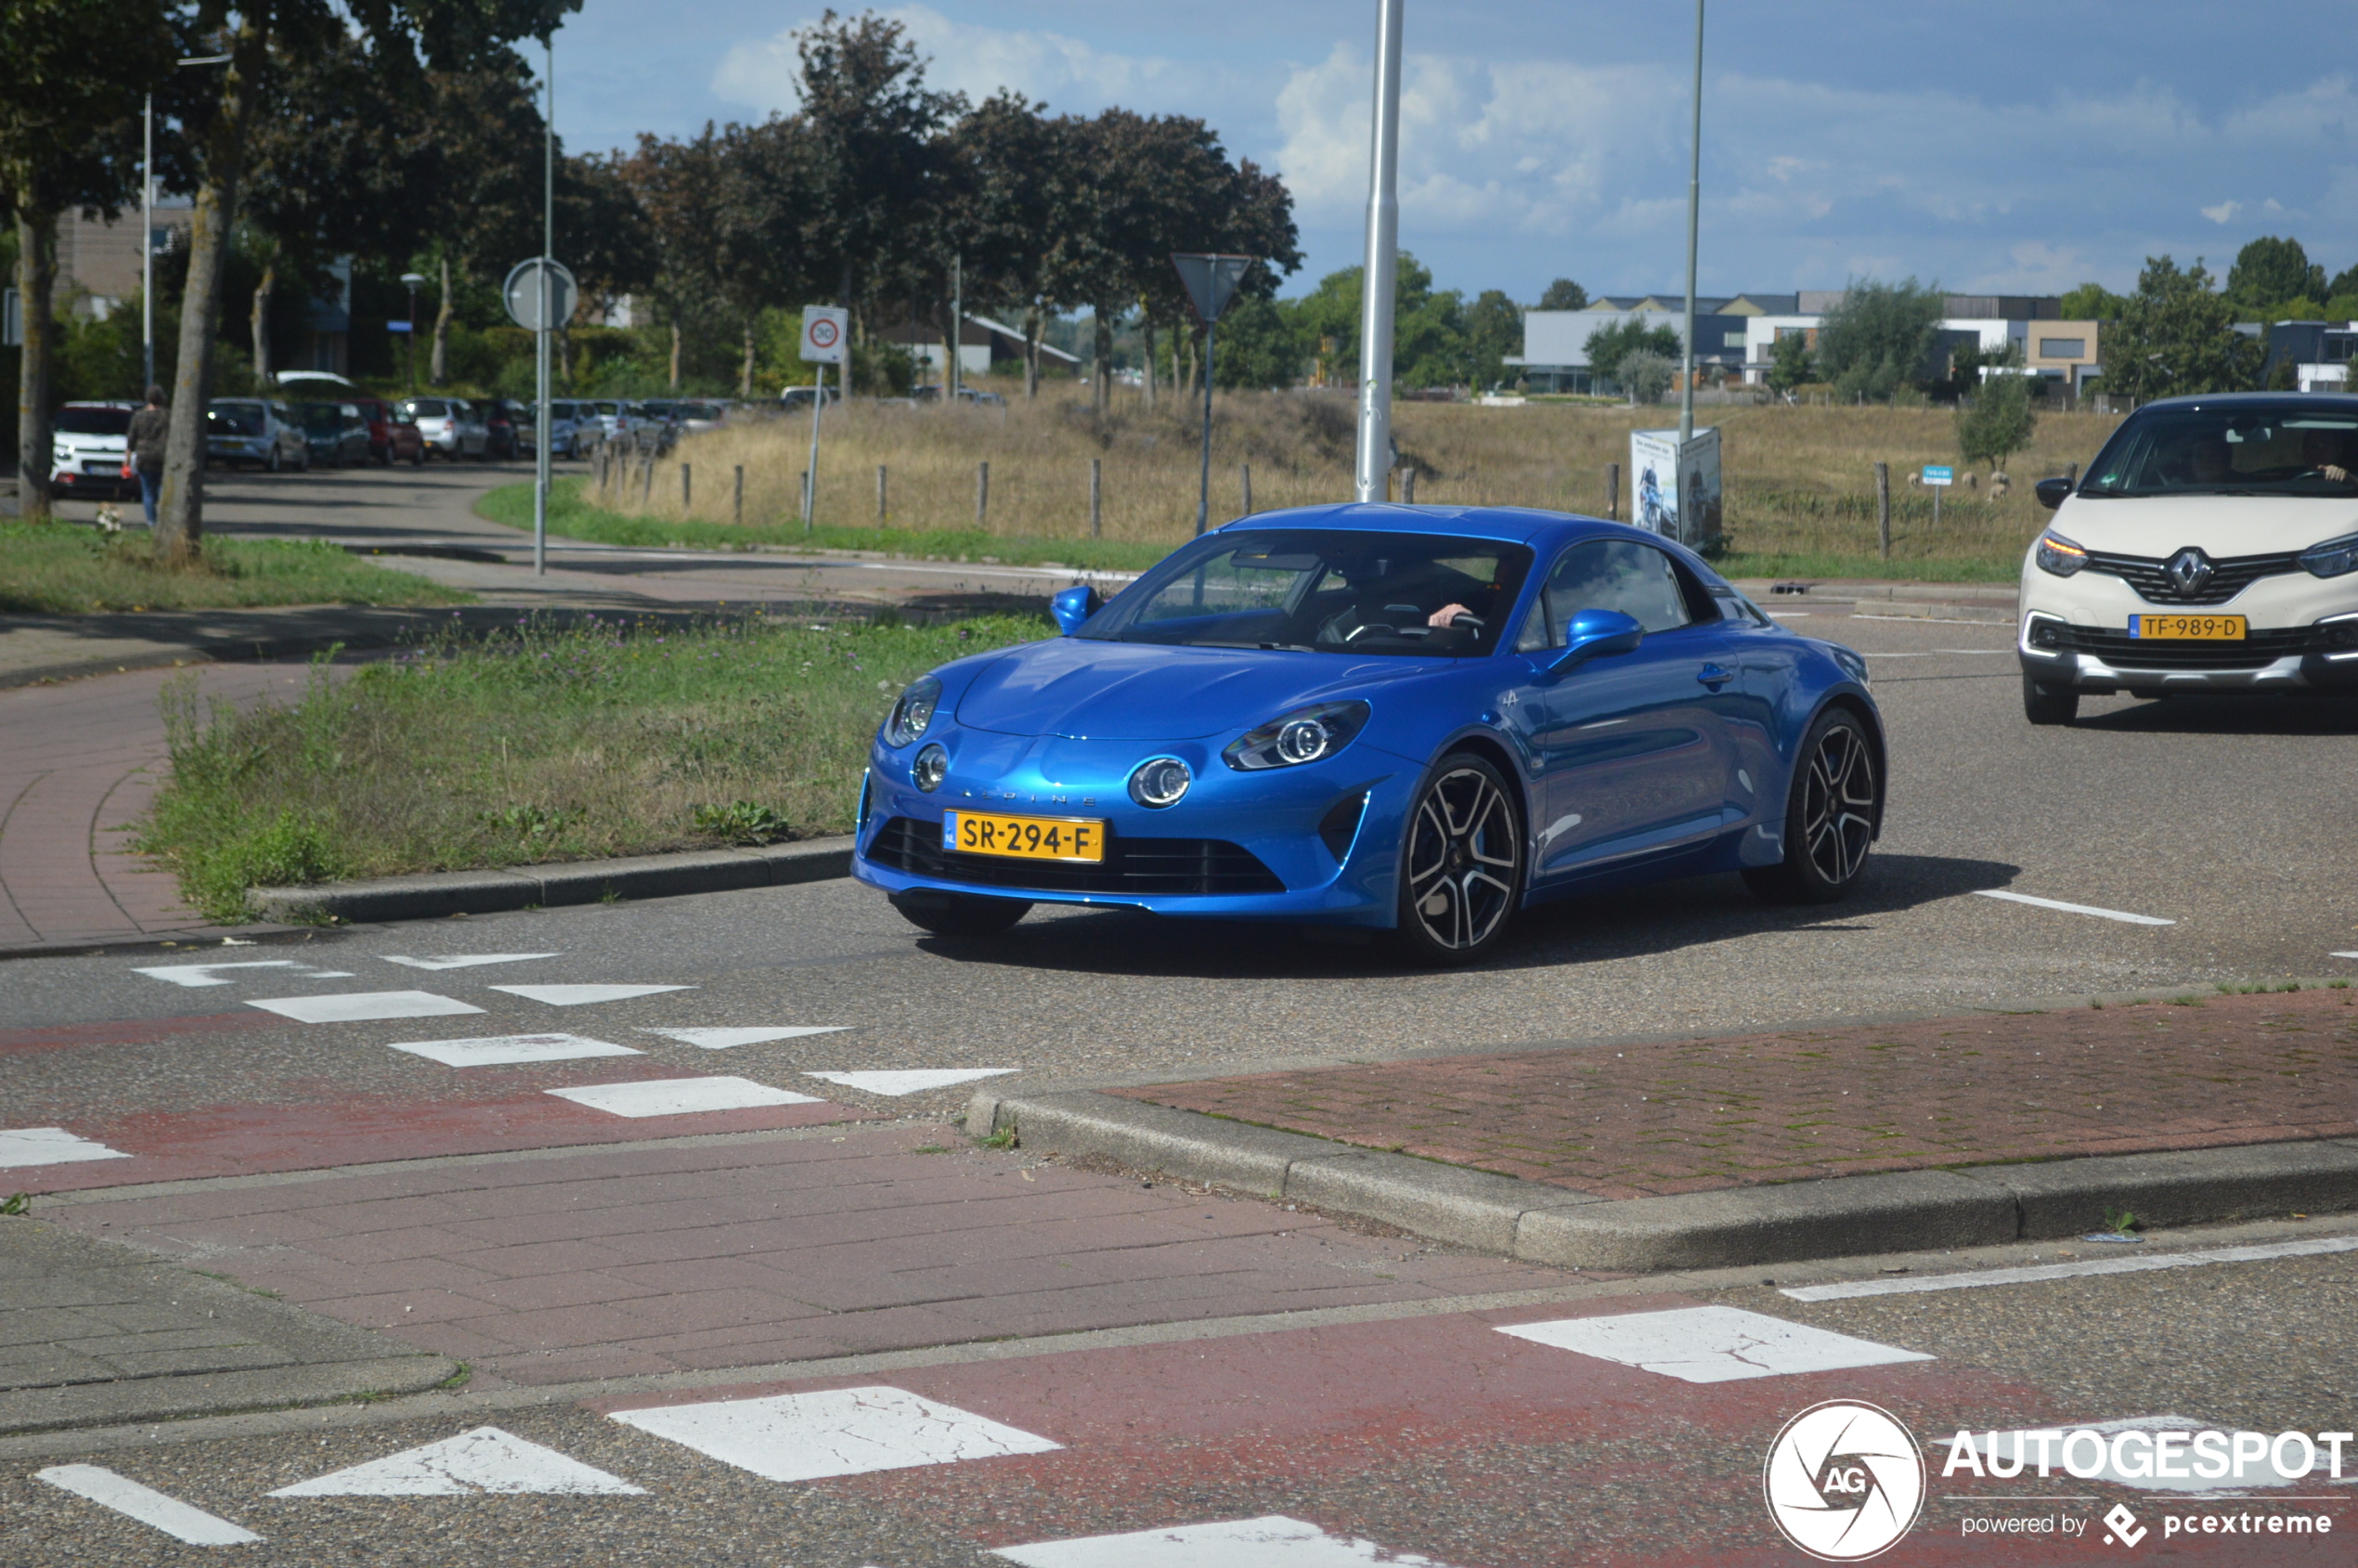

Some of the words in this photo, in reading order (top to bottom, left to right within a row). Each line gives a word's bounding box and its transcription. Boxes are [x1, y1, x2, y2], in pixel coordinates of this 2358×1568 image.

[816, 327, 834, 340] 30
[2145, 618, 2236, 636] TF-989-D
[962, 790, 1096, 807] ALPINE
[945, 834, 955, 844] NL
[964, 819, 1090, 855] SR-294-F
